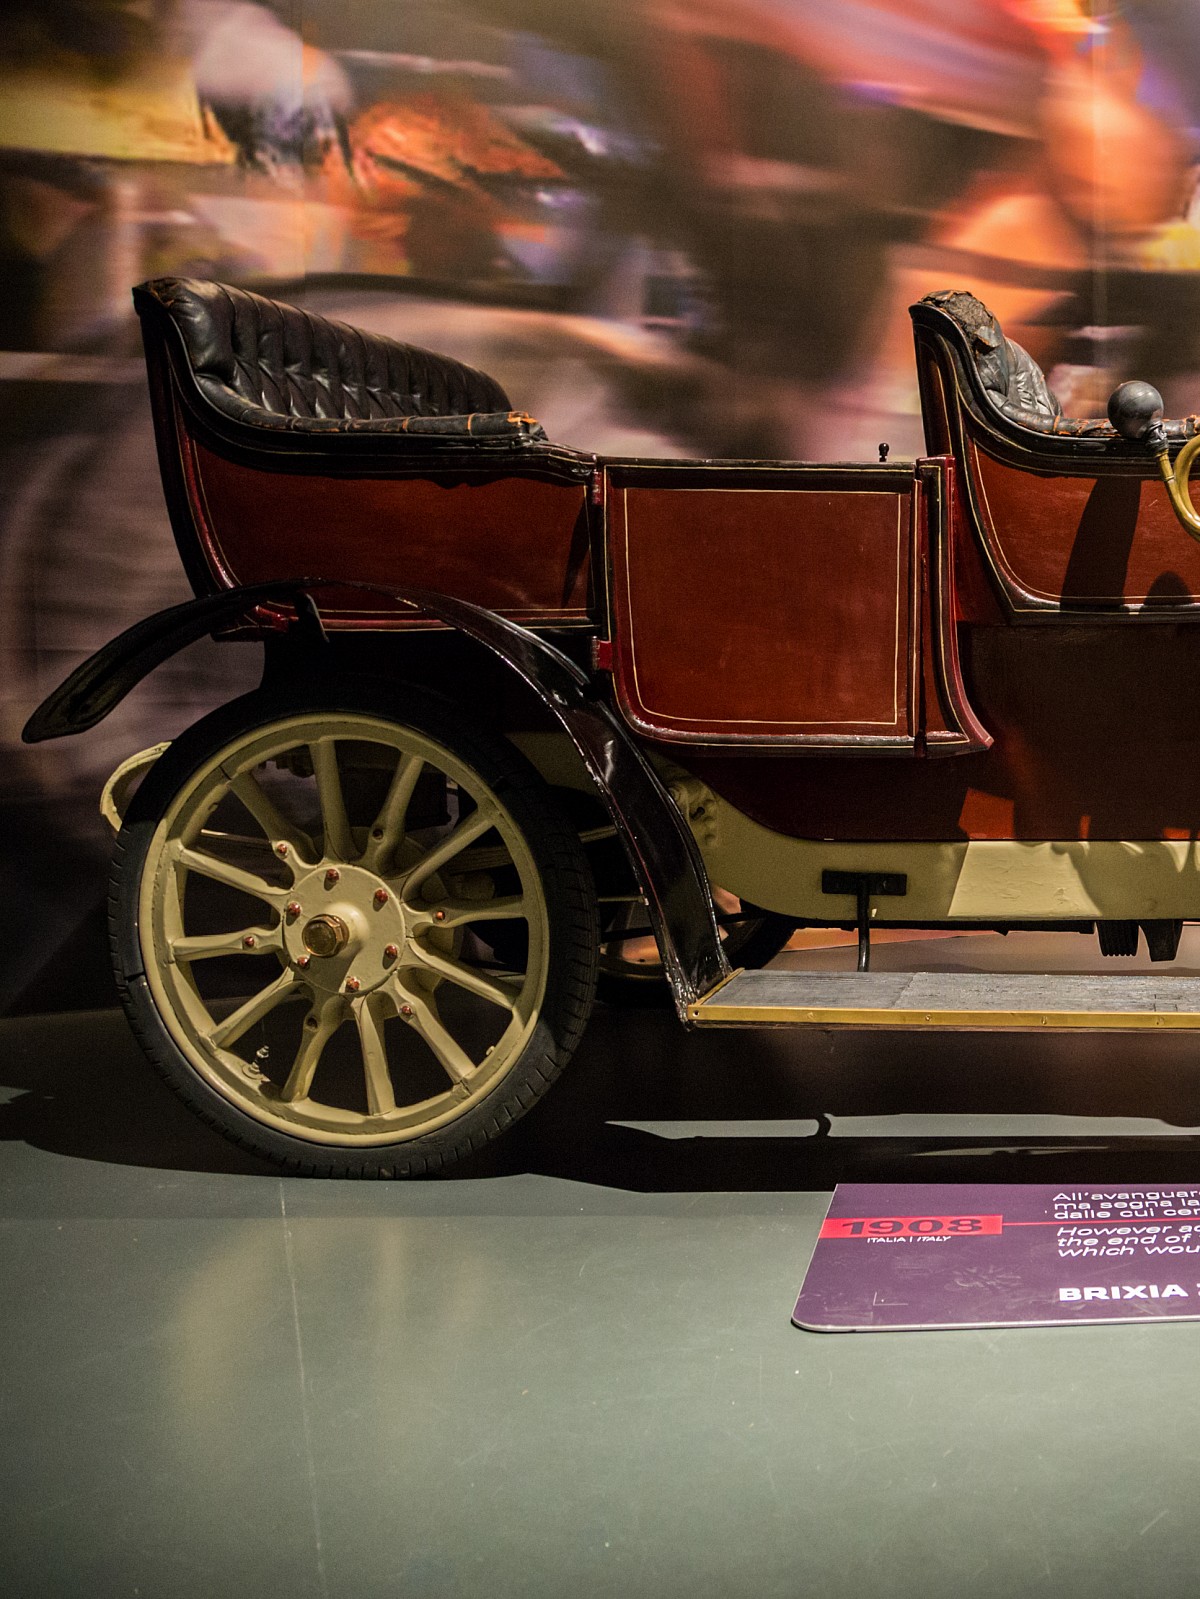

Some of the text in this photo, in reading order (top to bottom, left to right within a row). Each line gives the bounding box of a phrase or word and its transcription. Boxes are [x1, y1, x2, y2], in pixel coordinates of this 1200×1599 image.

[1055, 1202, 1091, 1210] ma
[1101, 1200, 1172, 1209] segna
[1182, 1199, 1199, 1207] la
[1054, 1210, 1110, 1219] dalle
[1120, 1208, 1154, 1217] cui
[842, 1219, 982, 1234] 1908
[1057, 1226, 1172, 1236] However
[1058, 1237, 1099, 1246] the
[1108, 1235, 1156, 1245] end
[1165, 1233, 1191, 1243] of
[1058, 1246, 1135, 1257] which
[1059, 1284, 1188, 1301] BRIXIA
